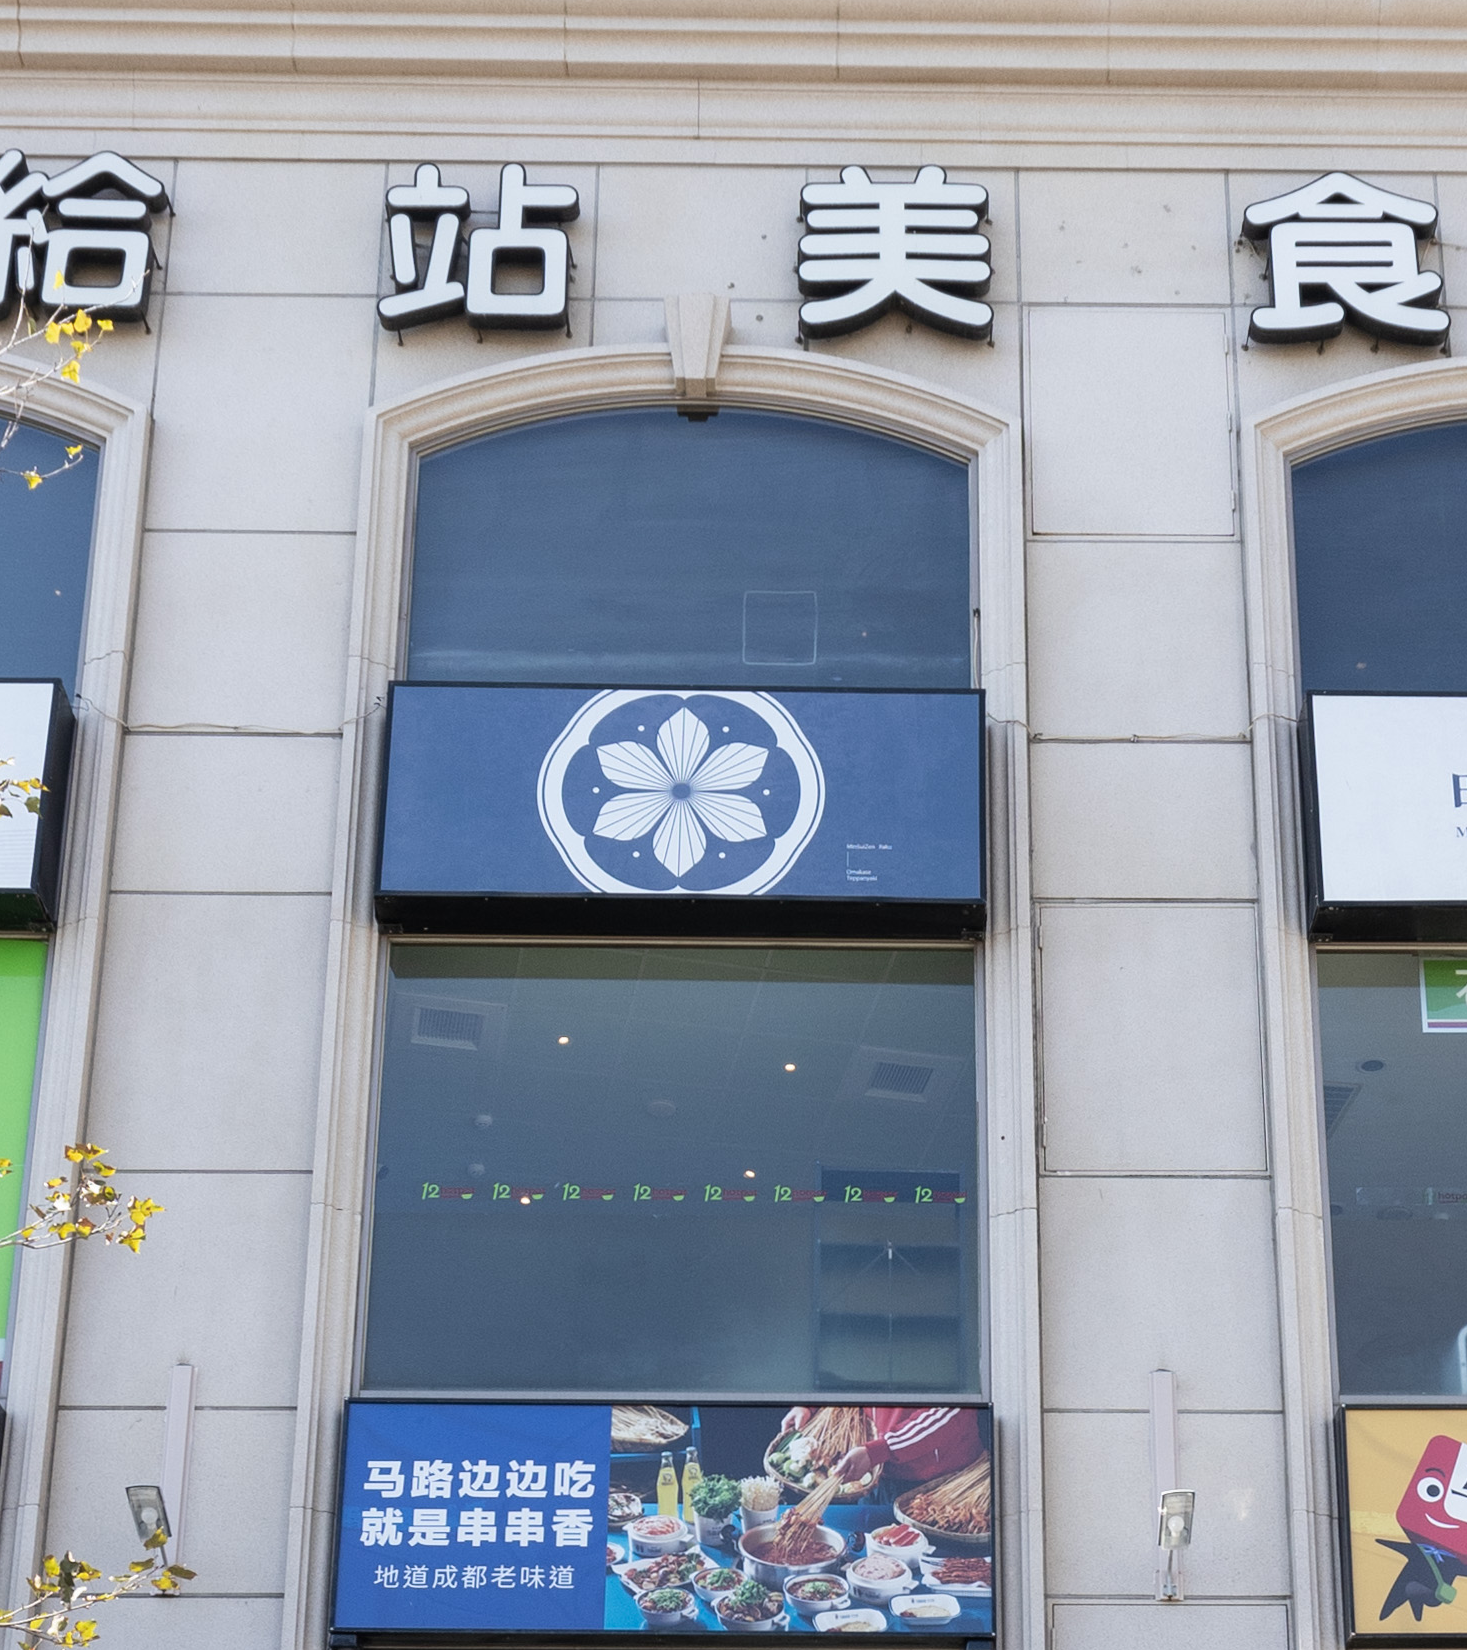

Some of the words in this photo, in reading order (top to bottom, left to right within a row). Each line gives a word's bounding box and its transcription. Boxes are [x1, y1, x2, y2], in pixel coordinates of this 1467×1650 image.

[363, 1459, 597, 1500] 马路边边吃
[359, 1507, 595, 1548] 就是串串香
[374, 1563, 576, 1590] 地道成都老味道
